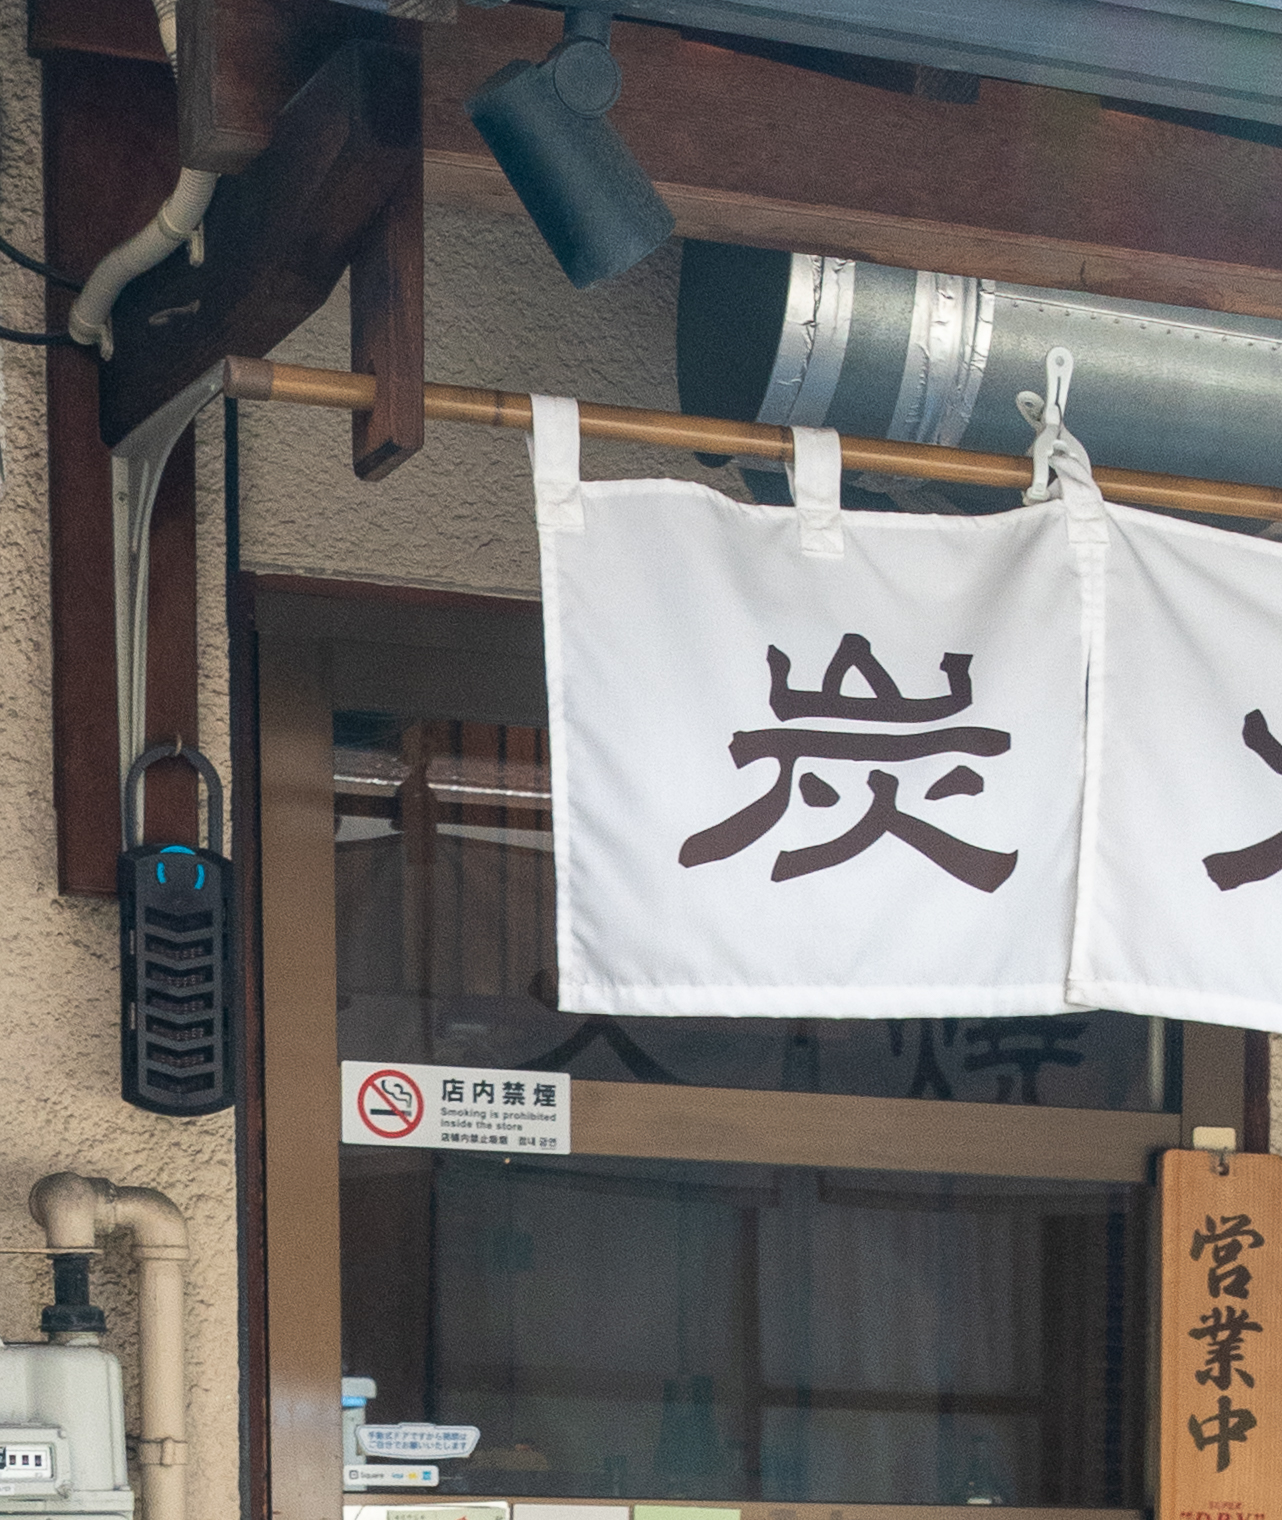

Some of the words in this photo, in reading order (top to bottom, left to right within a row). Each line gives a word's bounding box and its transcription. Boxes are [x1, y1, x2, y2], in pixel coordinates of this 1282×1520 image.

[441, 1078, 557, 1108] 店内禁煙
[440, 1107, 487, 1120] Smoking
[490, 1110, 499, 1119] is
[503, 1111, 557, 1122] prohibited
[476, 1121, 492, 1129] the
[496, 1122, 523, 1131] store
[1187, 1213, 1265, 1473] 営業中
